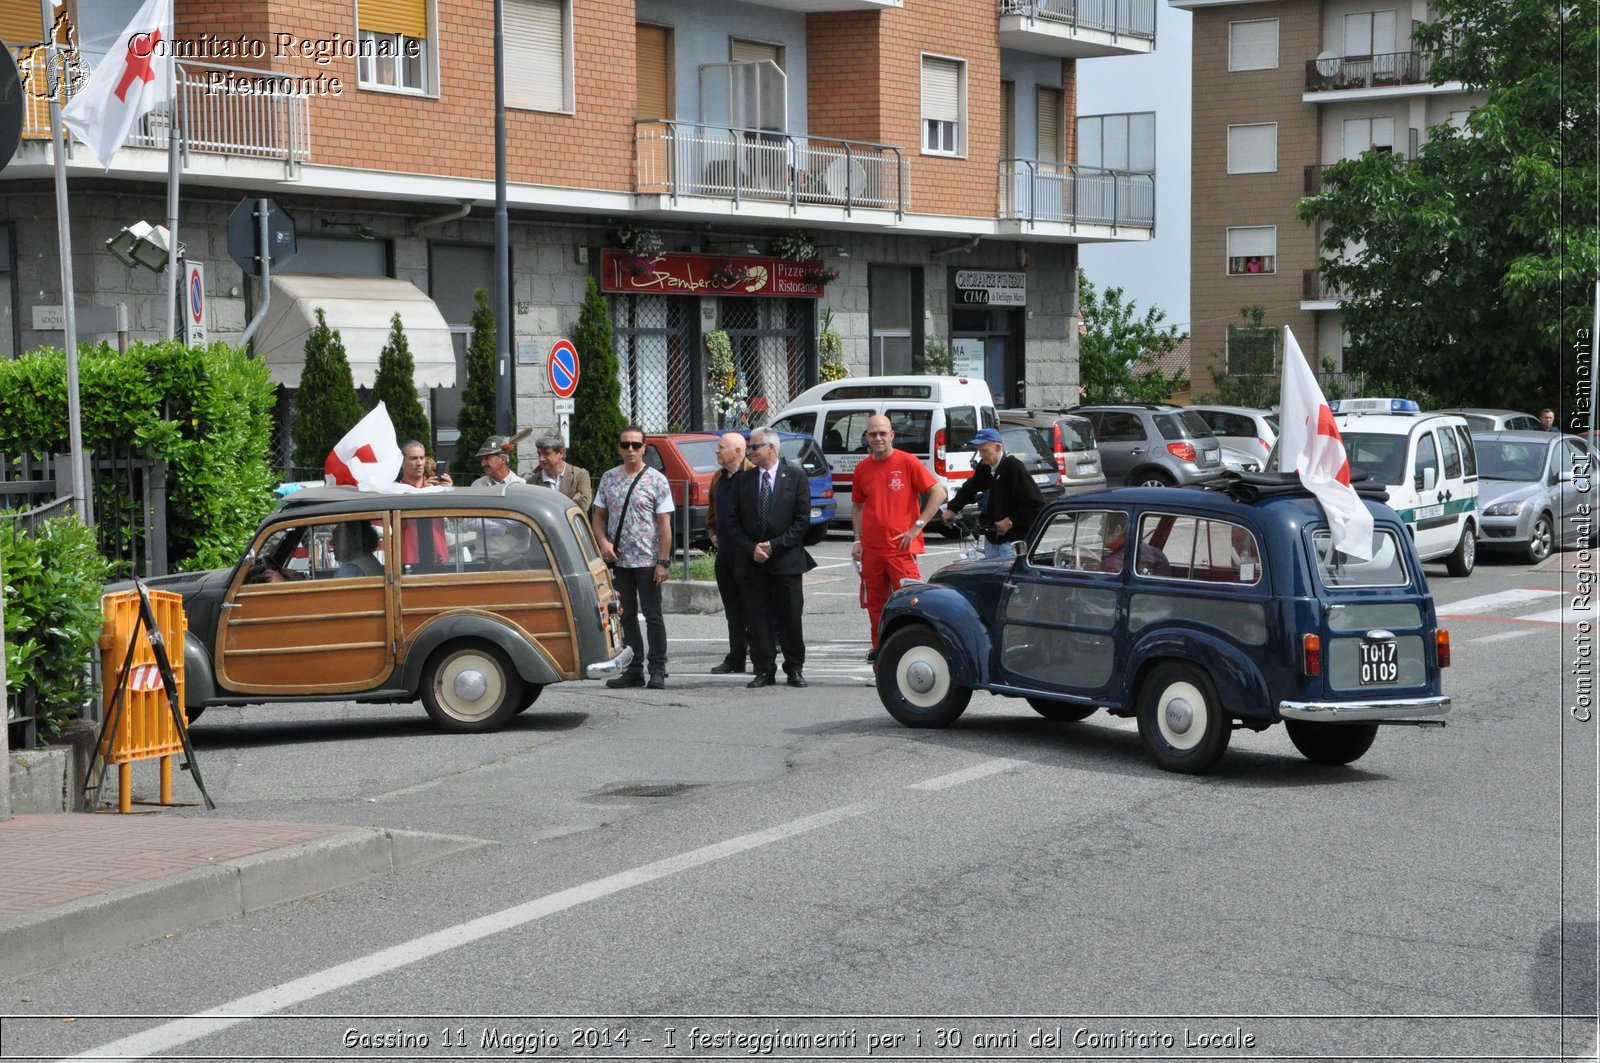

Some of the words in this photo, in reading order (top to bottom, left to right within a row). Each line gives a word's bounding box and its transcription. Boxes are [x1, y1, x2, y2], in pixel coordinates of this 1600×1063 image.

[778, 263, 813, 277] Pizzeri
[778, 279, 818, 293] Ristorante
[963, 290, 989, 303] CIMA
[1362, 663, 1397, 682] 0109
